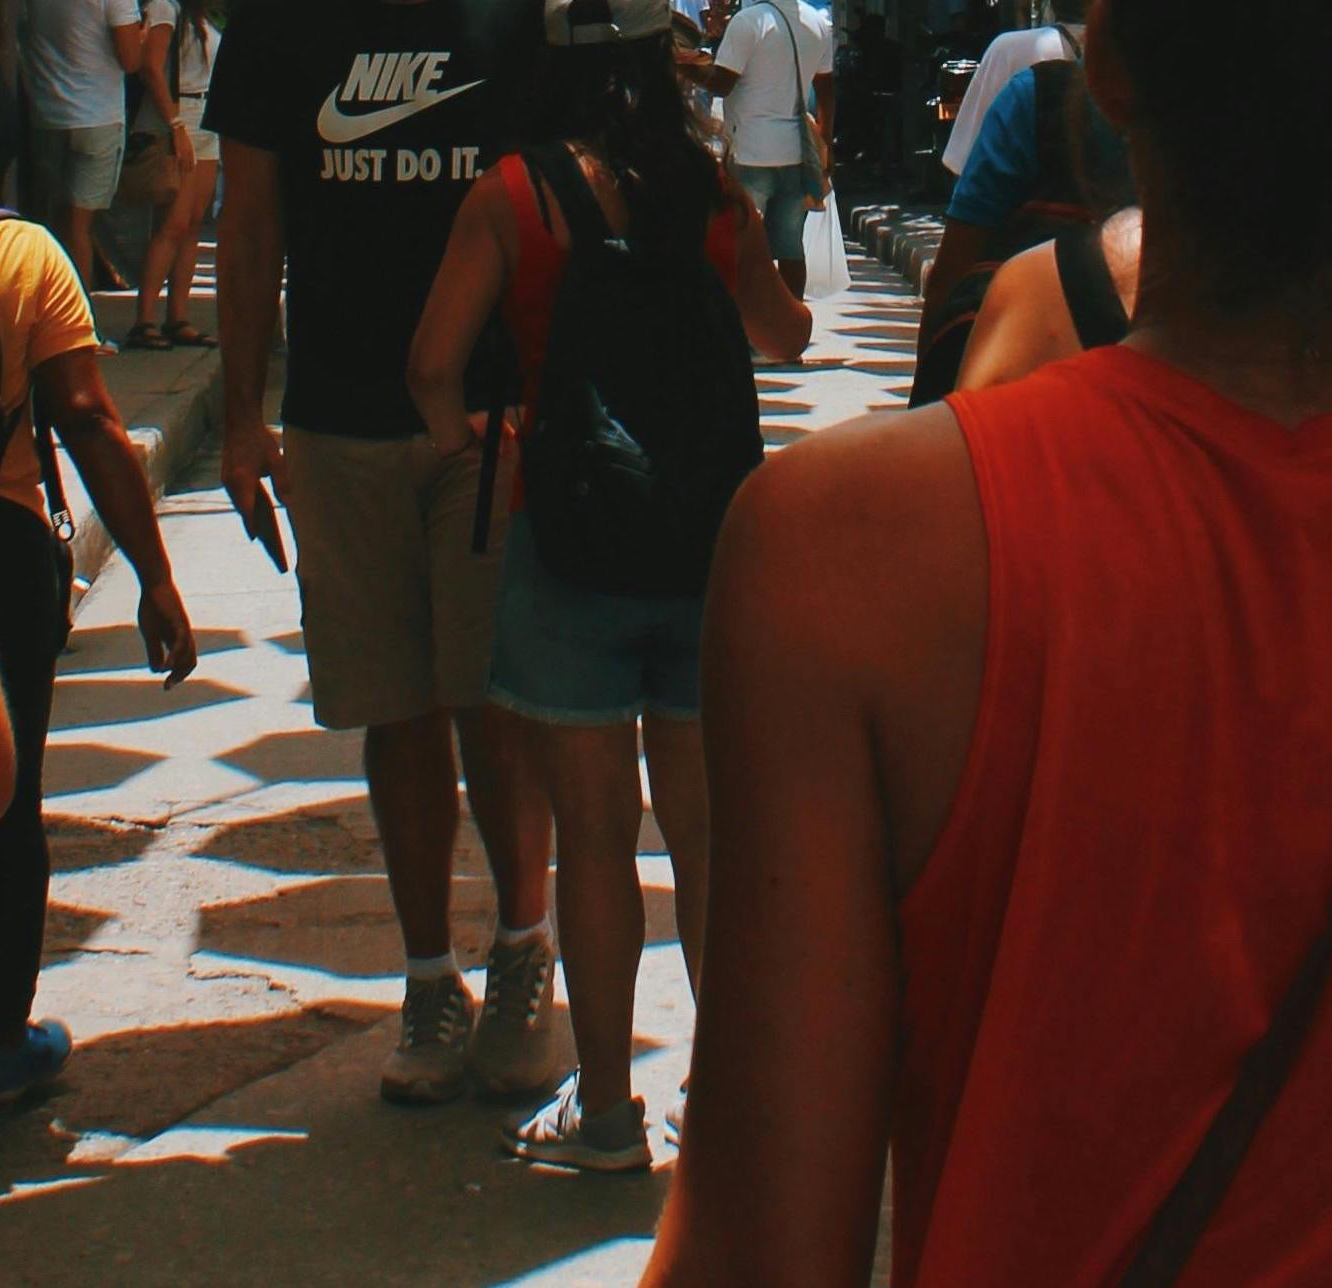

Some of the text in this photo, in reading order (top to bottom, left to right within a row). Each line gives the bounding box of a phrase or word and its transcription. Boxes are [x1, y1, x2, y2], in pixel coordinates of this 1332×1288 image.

[340, 52, 451, 102] NIKE
[320, 147, 484, 182] JUST DO IT.
